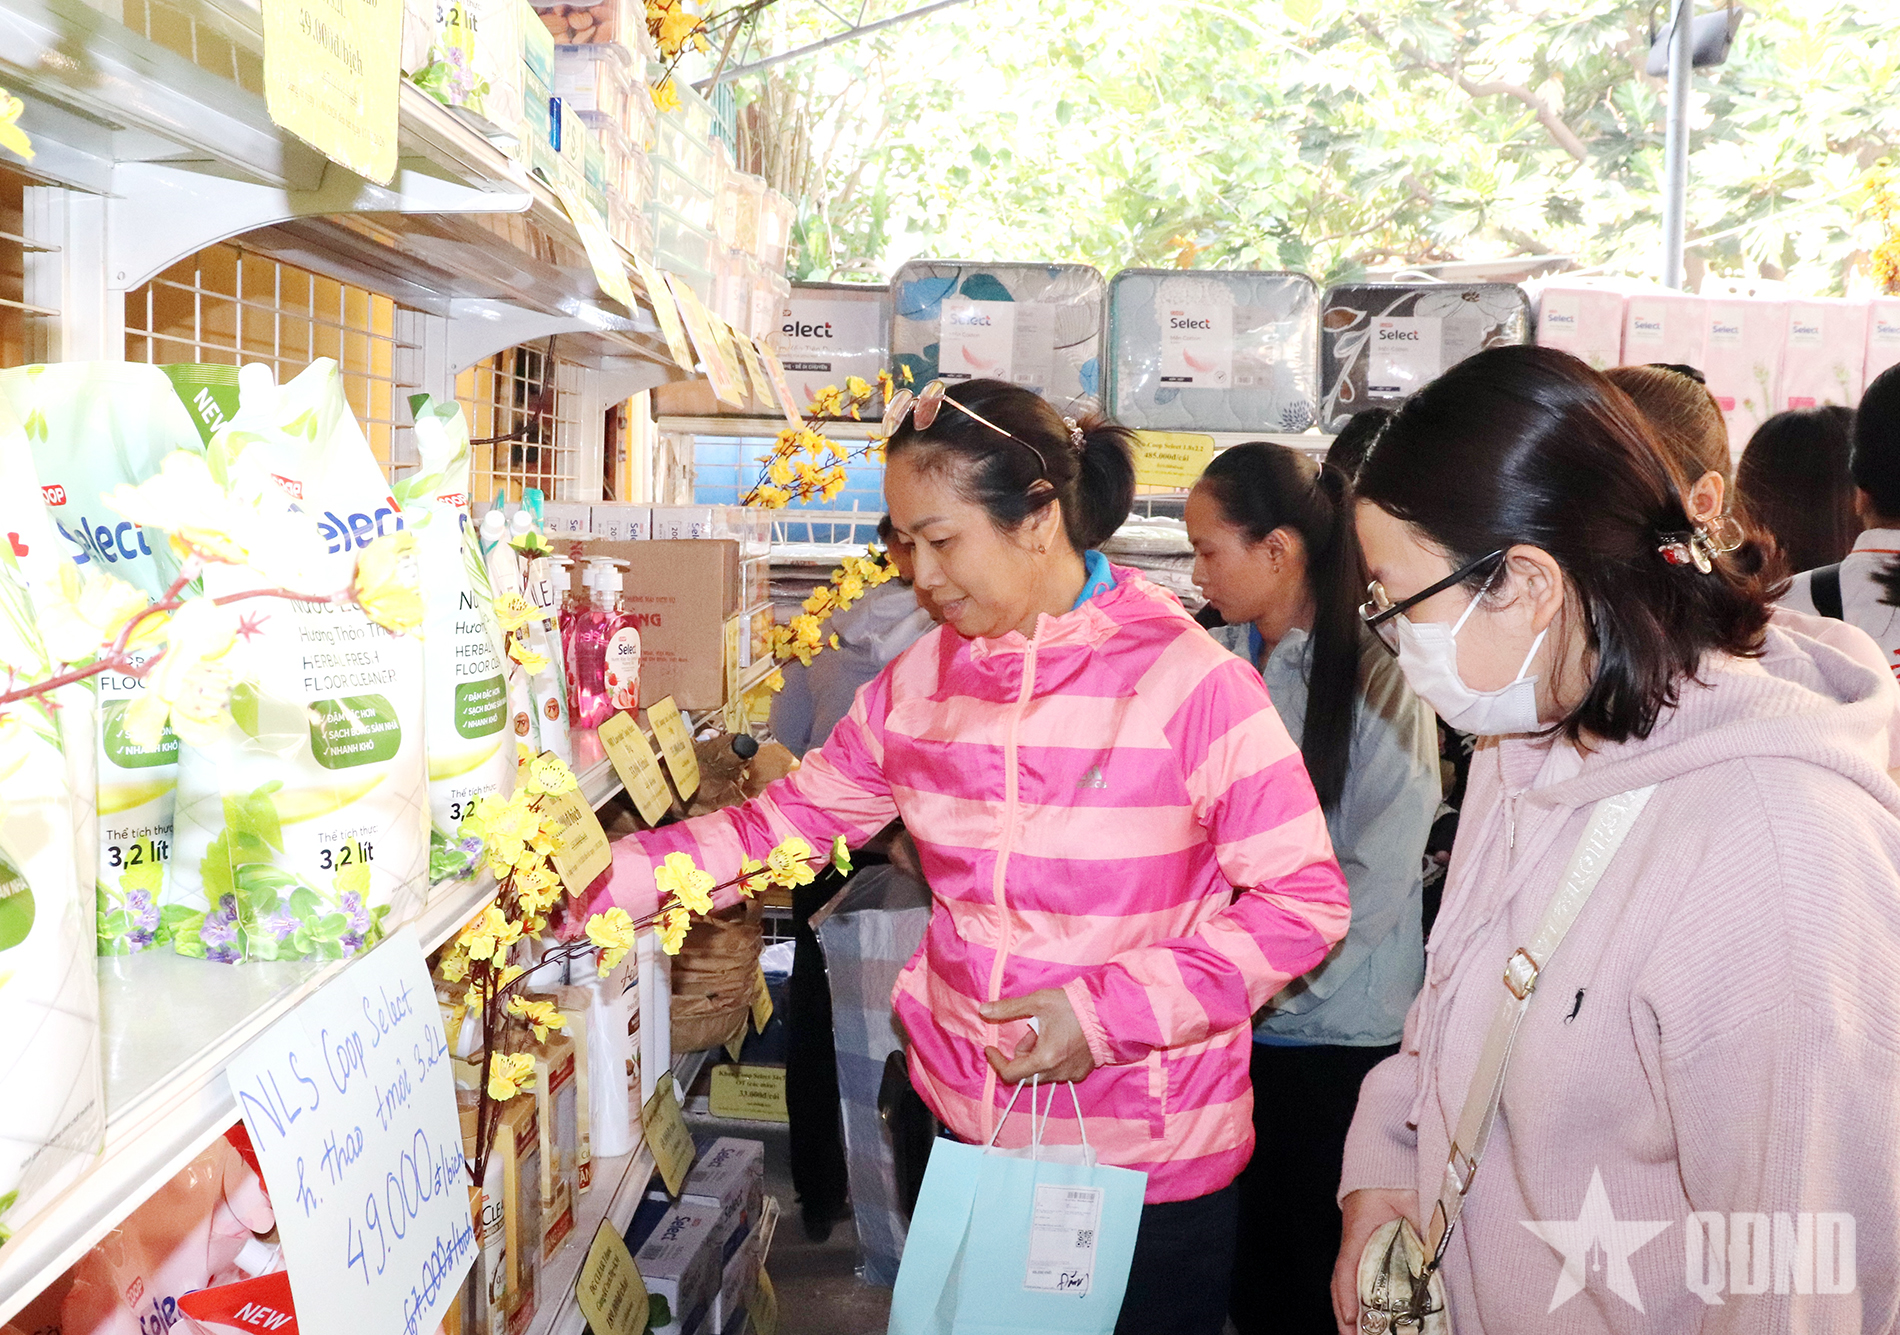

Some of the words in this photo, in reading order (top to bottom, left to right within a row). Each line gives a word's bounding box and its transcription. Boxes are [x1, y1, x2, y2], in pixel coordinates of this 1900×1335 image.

[1170, 318, 1211, 329] Select
[1548, 314, 1575, 322] Select
[782, 321, 833, 338] elect
[1634, 321, 1660, 330] Select
[1712, 325, 1738, 333] Select
[1793, 325, 1819, 334] Select
[1877, 325, 1900, 334] Selec
[1379, 329, 1419, 341] Select
[42, 486, 65, 505] OOP
[641, 613, 662, 627] NG
[450, 801, 475, 822] 3,2
[106, 827, 129, 840] Thể
[131, 827, 151, 839] tích
[108, 844, 143, 870] 3,2
[151, 840, 169, 862] lít
[320, 845, 352, 872] 3,2
[358, 841, 374, 863] lít
[239, 1051, 320, 1152] NLS
[321, 1028, 368, 1095] Coop
[362, 979, 413, 1048] Select
[661, 1215, 691, 1241] Select
[233, 1302, 292, 1331] NEW
